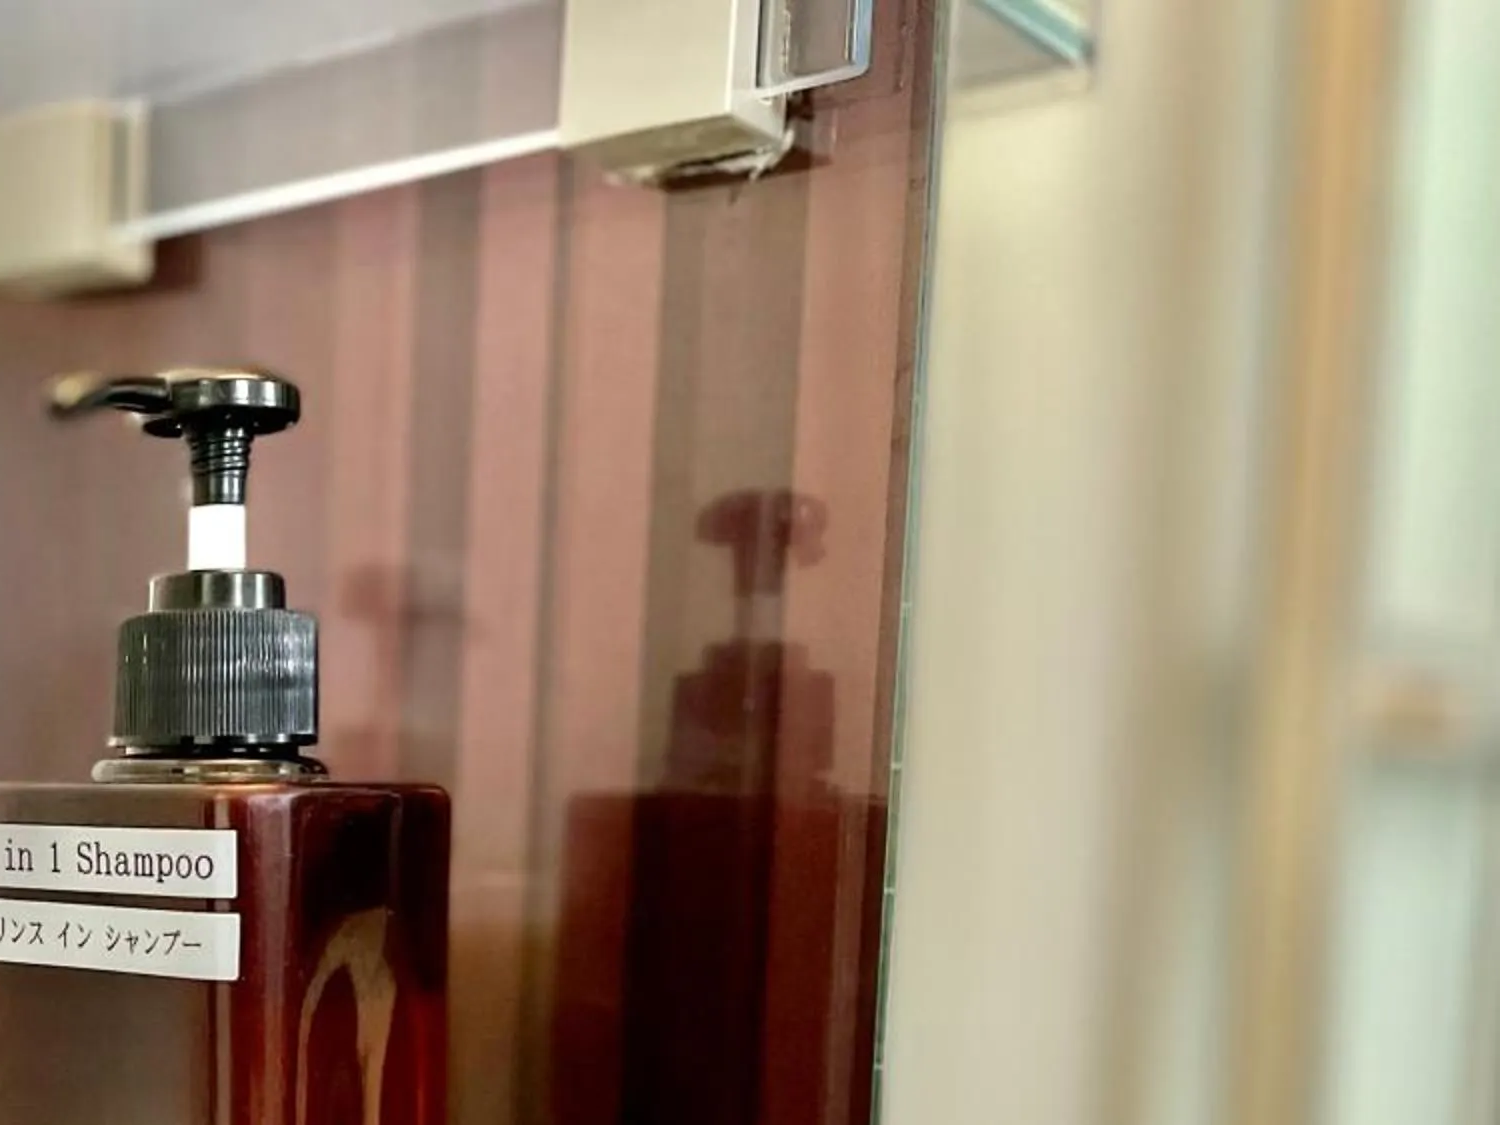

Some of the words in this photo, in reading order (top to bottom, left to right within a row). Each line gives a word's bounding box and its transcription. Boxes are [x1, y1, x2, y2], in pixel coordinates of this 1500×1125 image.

[4, 838, 34, 872] in
[50, 841, 62, 873] 1
[76, 841, 214, 882] Shampoo
[57, 921, 93, 949] イン
